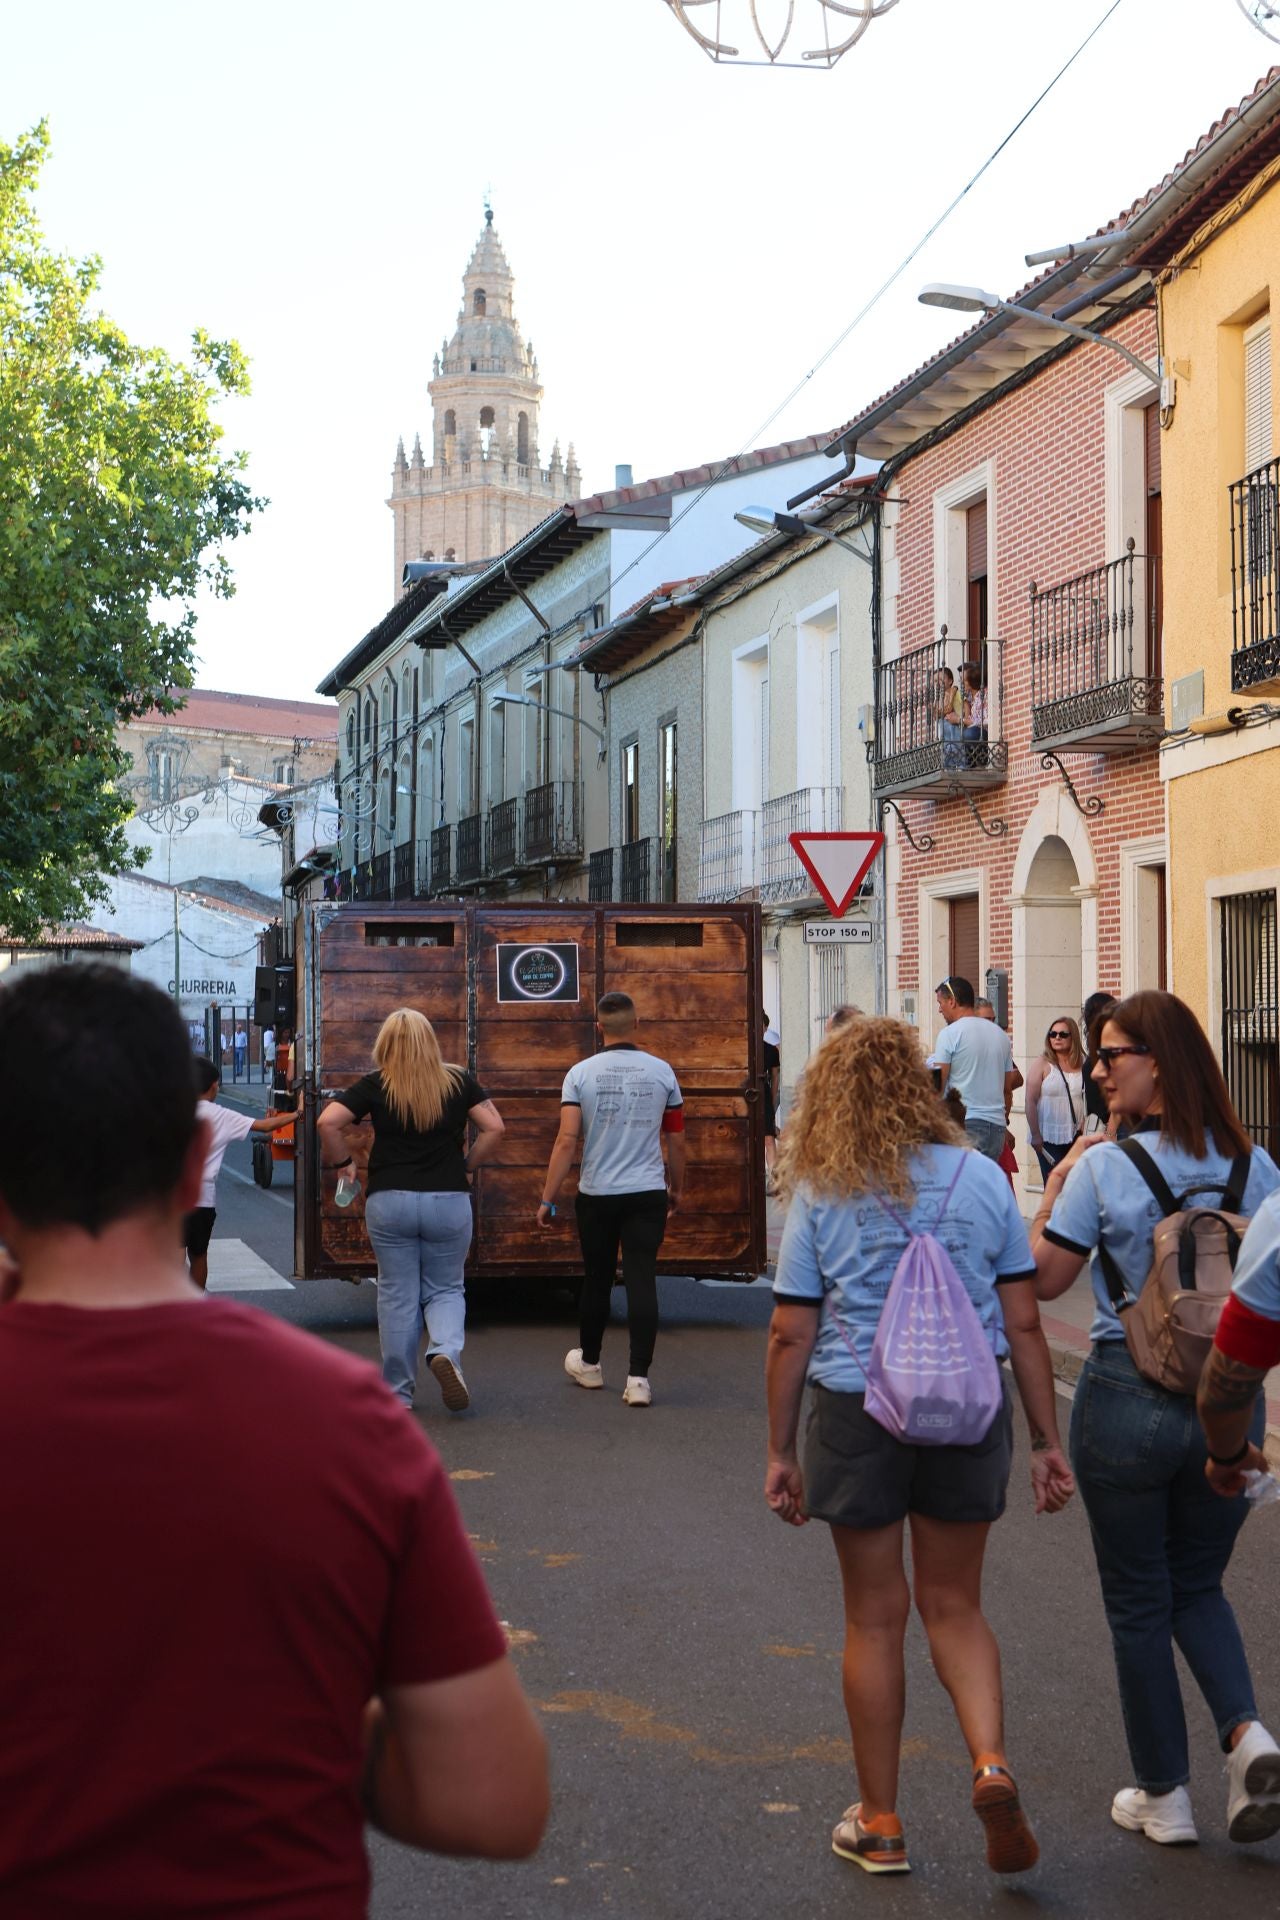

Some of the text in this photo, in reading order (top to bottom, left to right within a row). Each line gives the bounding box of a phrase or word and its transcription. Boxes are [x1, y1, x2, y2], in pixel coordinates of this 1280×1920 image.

[808, 928, 836, 937] STOP
[840, 928, 858, 937] 150
[167, 979, 237, 995] CHURRERIA
